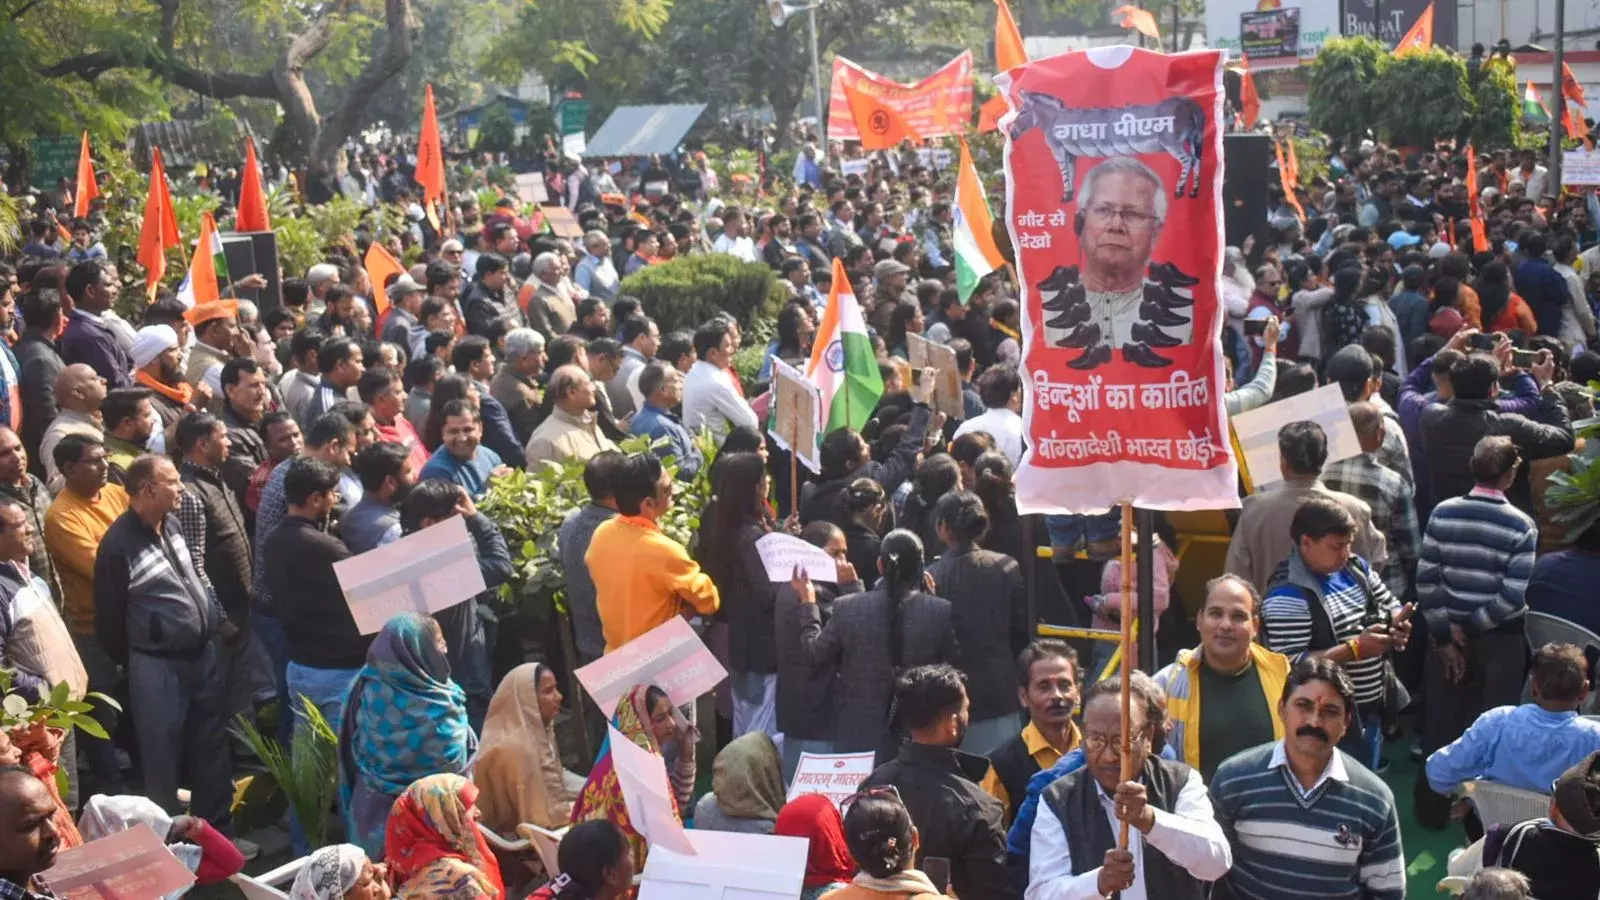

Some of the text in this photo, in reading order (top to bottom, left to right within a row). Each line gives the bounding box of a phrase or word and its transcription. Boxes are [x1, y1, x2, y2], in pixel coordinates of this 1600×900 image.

[1053, 112, 1176, 140] गधा पीएम
[1018, 209, 1067, 227] गौर से
[1019, 232, 1052, 249] देखो
[1034, 369, 1208, 423] हिन्दूओं का कातिल
[1125, 437, 1172, 460] भारत
